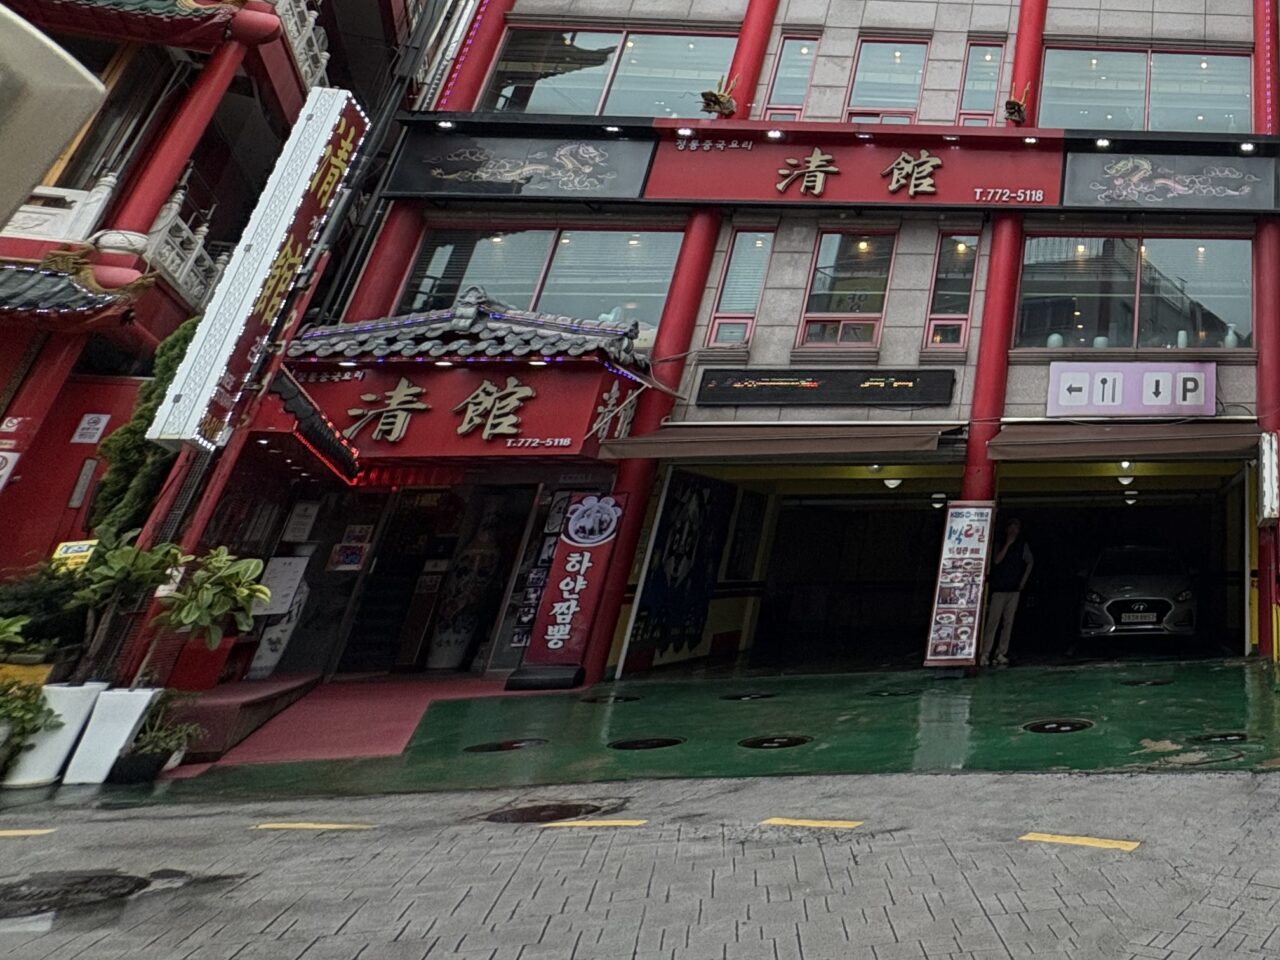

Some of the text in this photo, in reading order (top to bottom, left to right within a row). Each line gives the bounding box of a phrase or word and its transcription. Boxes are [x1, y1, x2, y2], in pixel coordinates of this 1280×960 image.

[675, 139, 753, 151] 정통중국요리
[974, 188, 1044, 203] T.772-5118
[1182, 377, 1199, 401] P
[505, 437, 572, 448] T.772-5118
[544, 551, 593, 649] 하얀짬뽕
